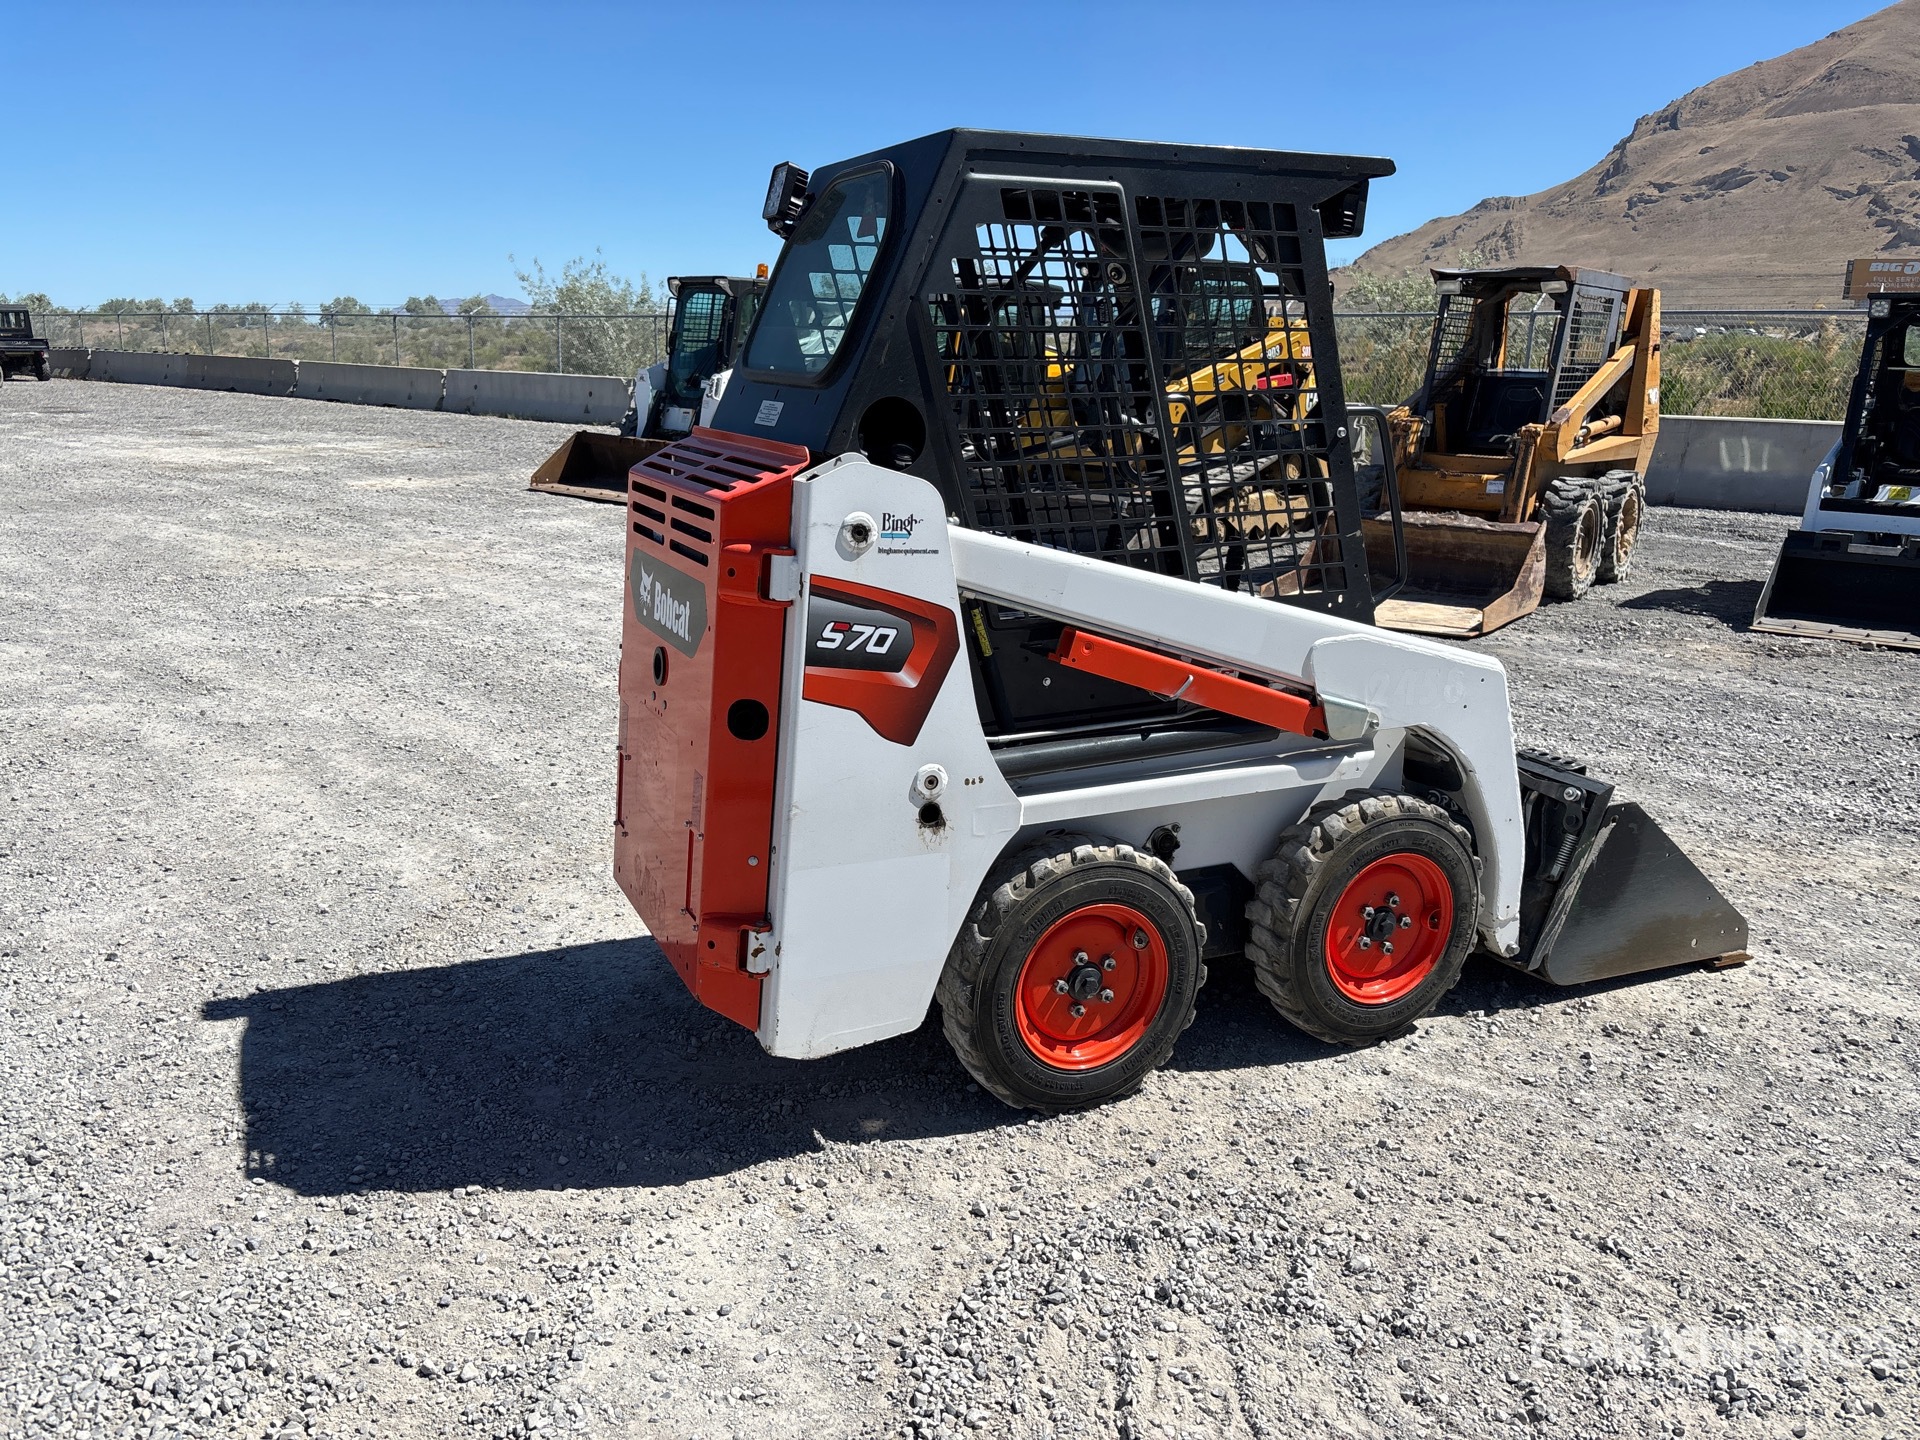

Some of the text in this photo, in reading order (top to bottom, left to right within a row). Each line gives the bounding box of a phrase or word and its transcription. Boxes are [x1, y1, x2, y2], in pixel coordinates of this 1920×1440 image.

[1869, 262, 1904, 272] BIG
[881, 512, 924, 537] Bingh
[877, 546, 940, 556] binghamequipment.com
[653, 580, 691, 642] Bobcat
[816, 620, 899, 654] S70
